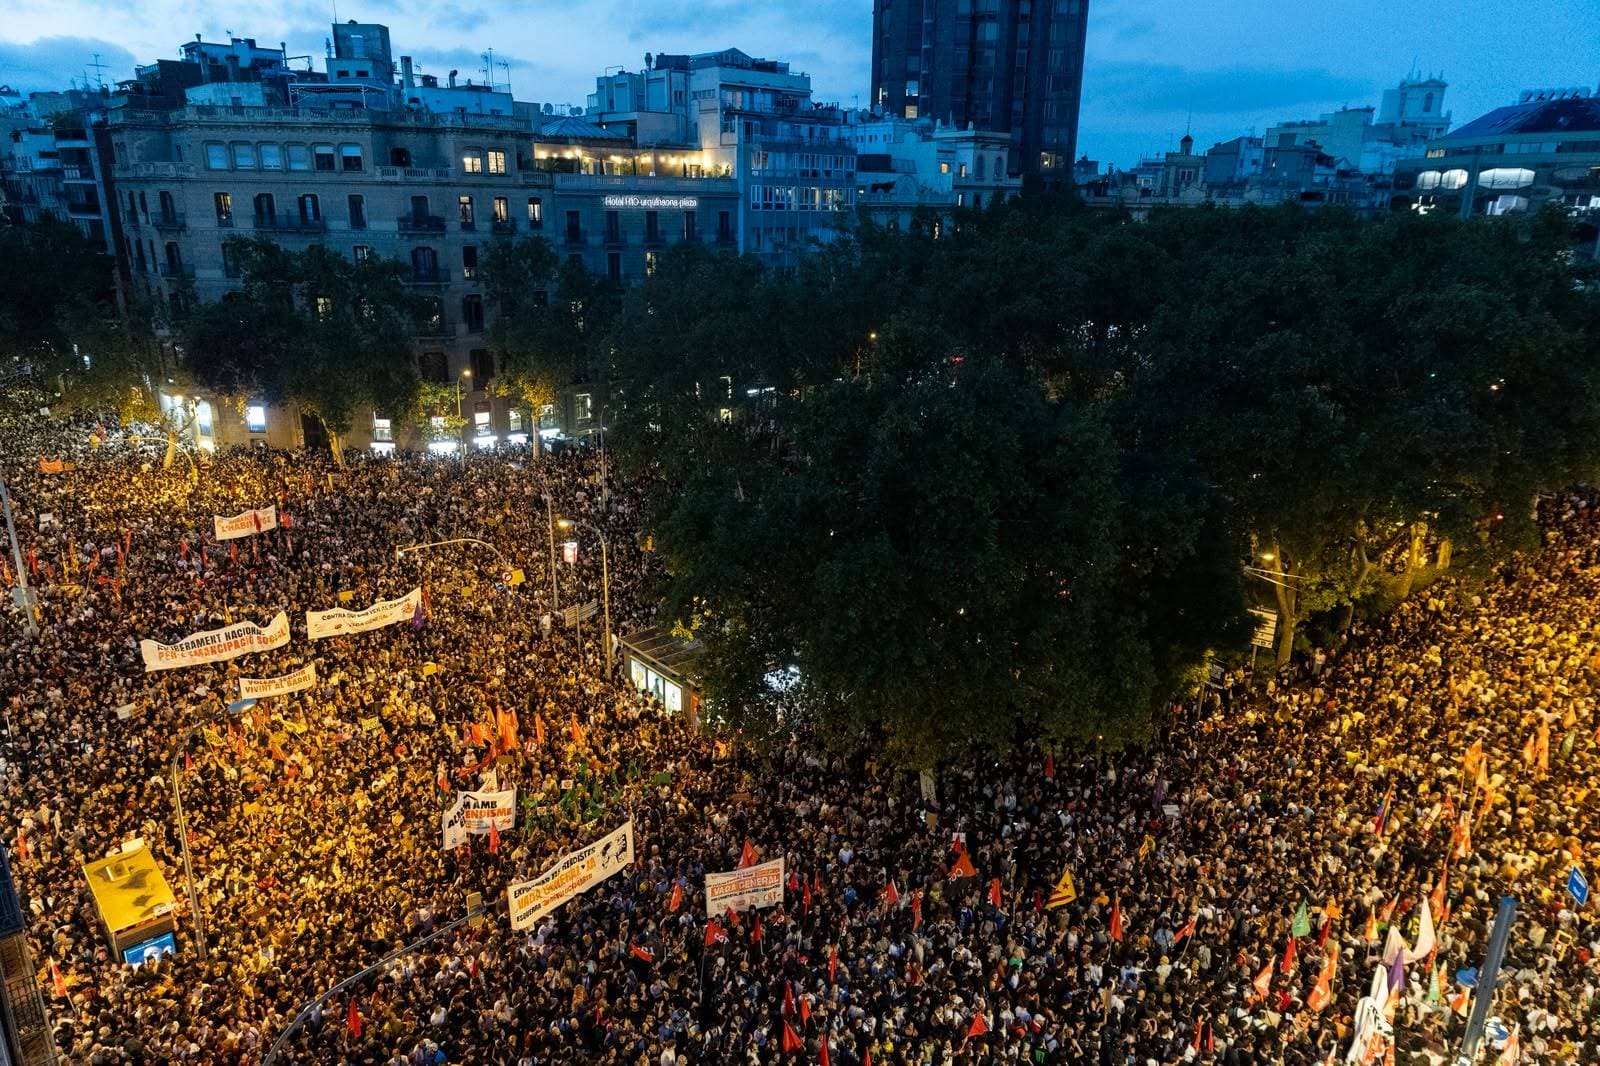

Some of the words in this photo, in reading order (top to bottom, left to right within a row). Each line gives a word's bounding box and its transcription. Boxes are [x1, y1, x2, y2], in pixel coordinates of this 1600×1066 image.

[244, 684, 272, 694] VIVINT
[274, 682, 285, 690] AL
[286, 673, 312, 687] BARRI
[713, 883, 737, 896] VAGA
[738, 874, 780, 890] GENERAL
